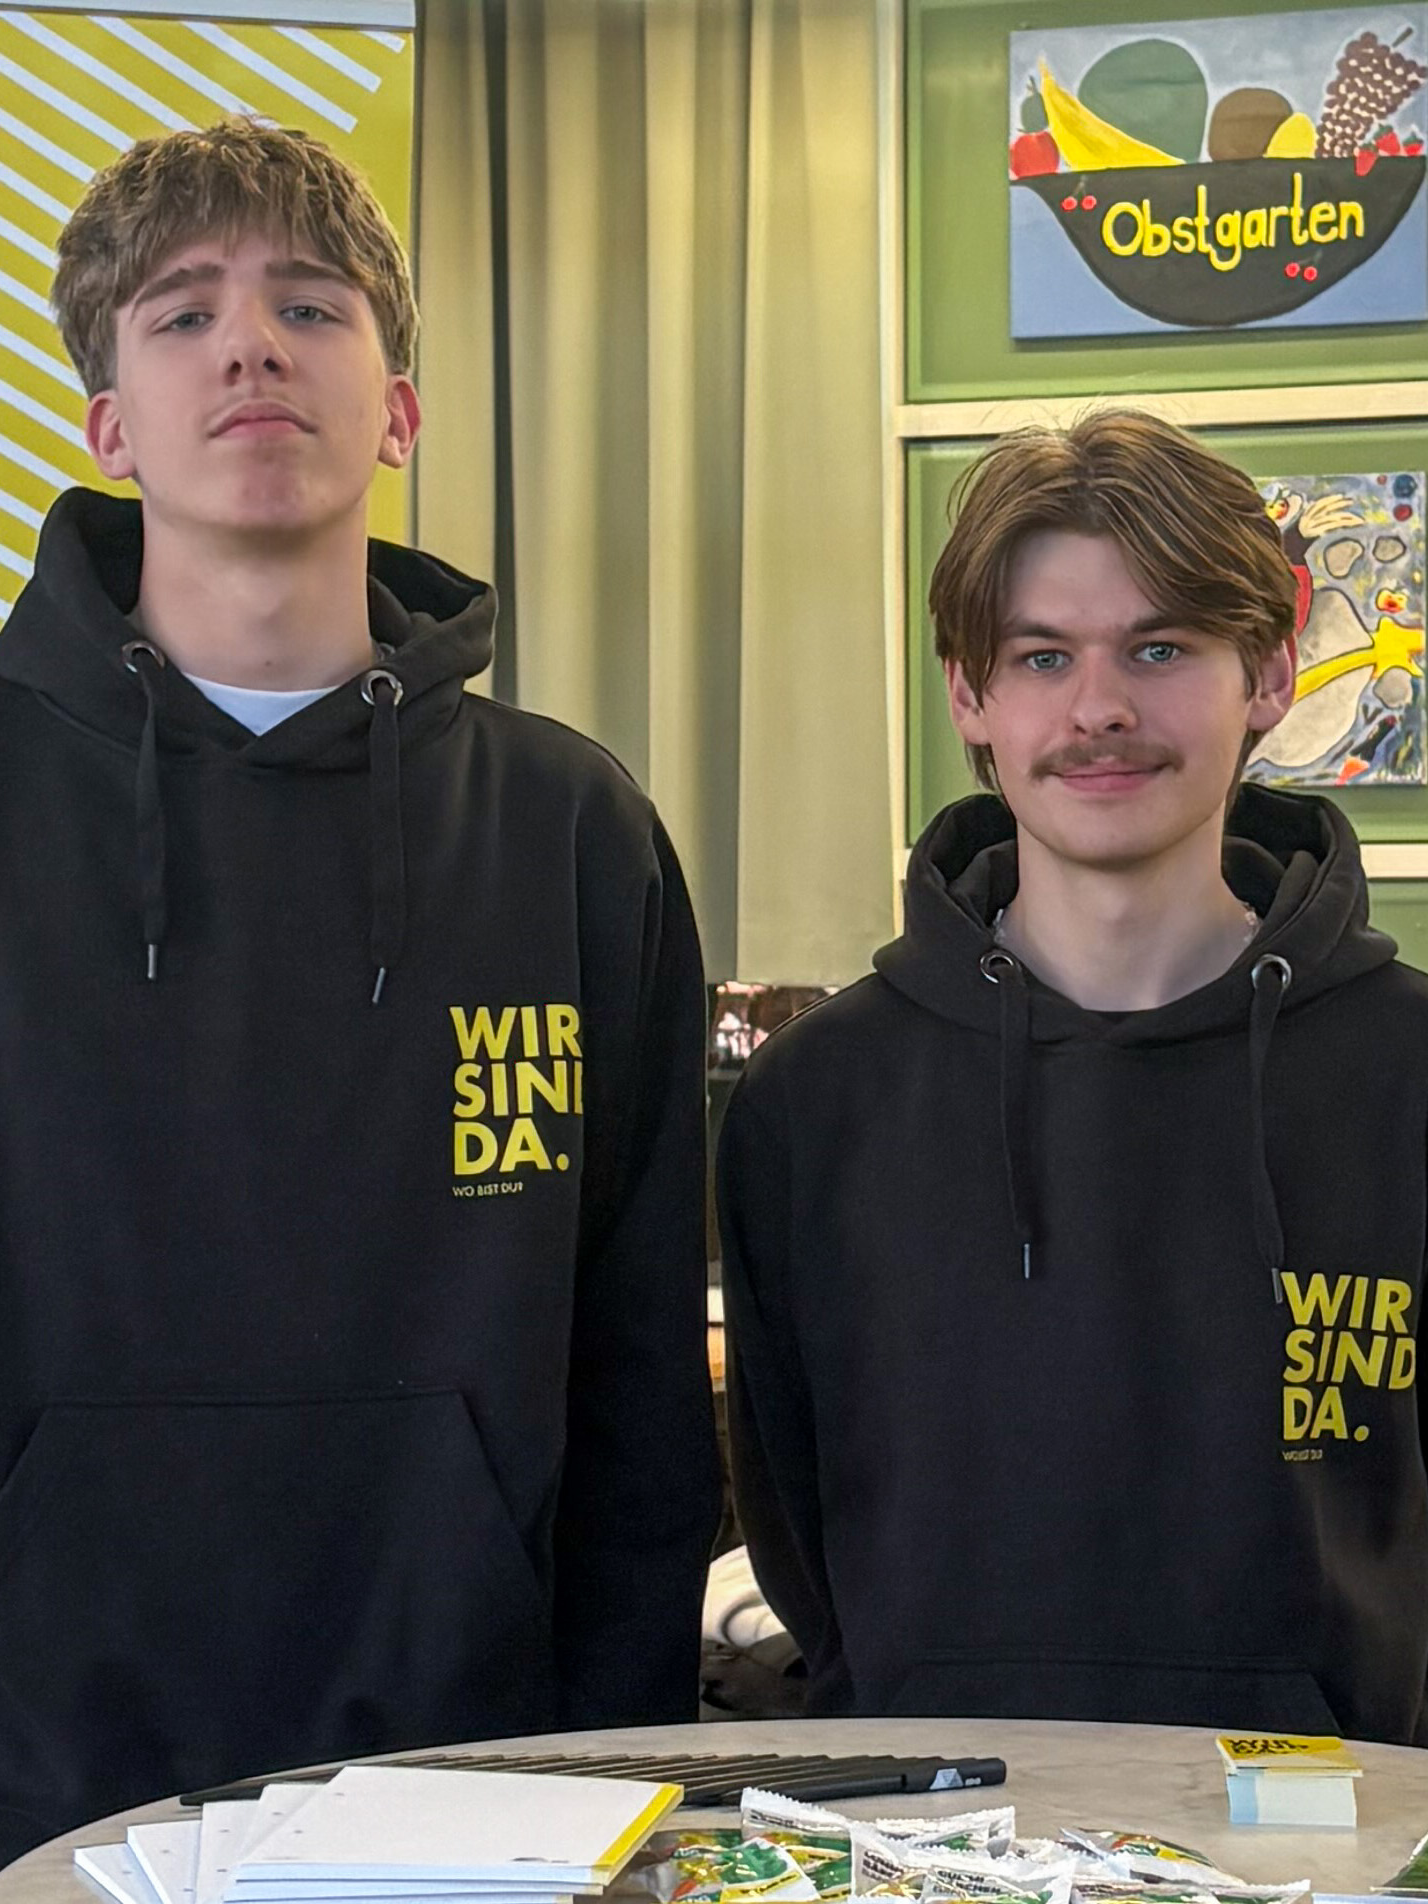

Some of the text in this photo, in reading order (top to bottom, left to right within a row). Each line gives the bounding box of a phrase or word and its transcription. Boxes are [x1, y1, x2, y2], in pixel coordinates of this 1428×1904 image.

[1102, 172, 1365, 271] Obstgarten
[449, 1003, 583, 1060] WIR
[454, 1117, 570, 1176] DA.
[1280, 1271, 1413, 1334] WIR
[1283, 1328, 1417, 1390] SIND
[1283, 1385, 1370, 1442] DA.
